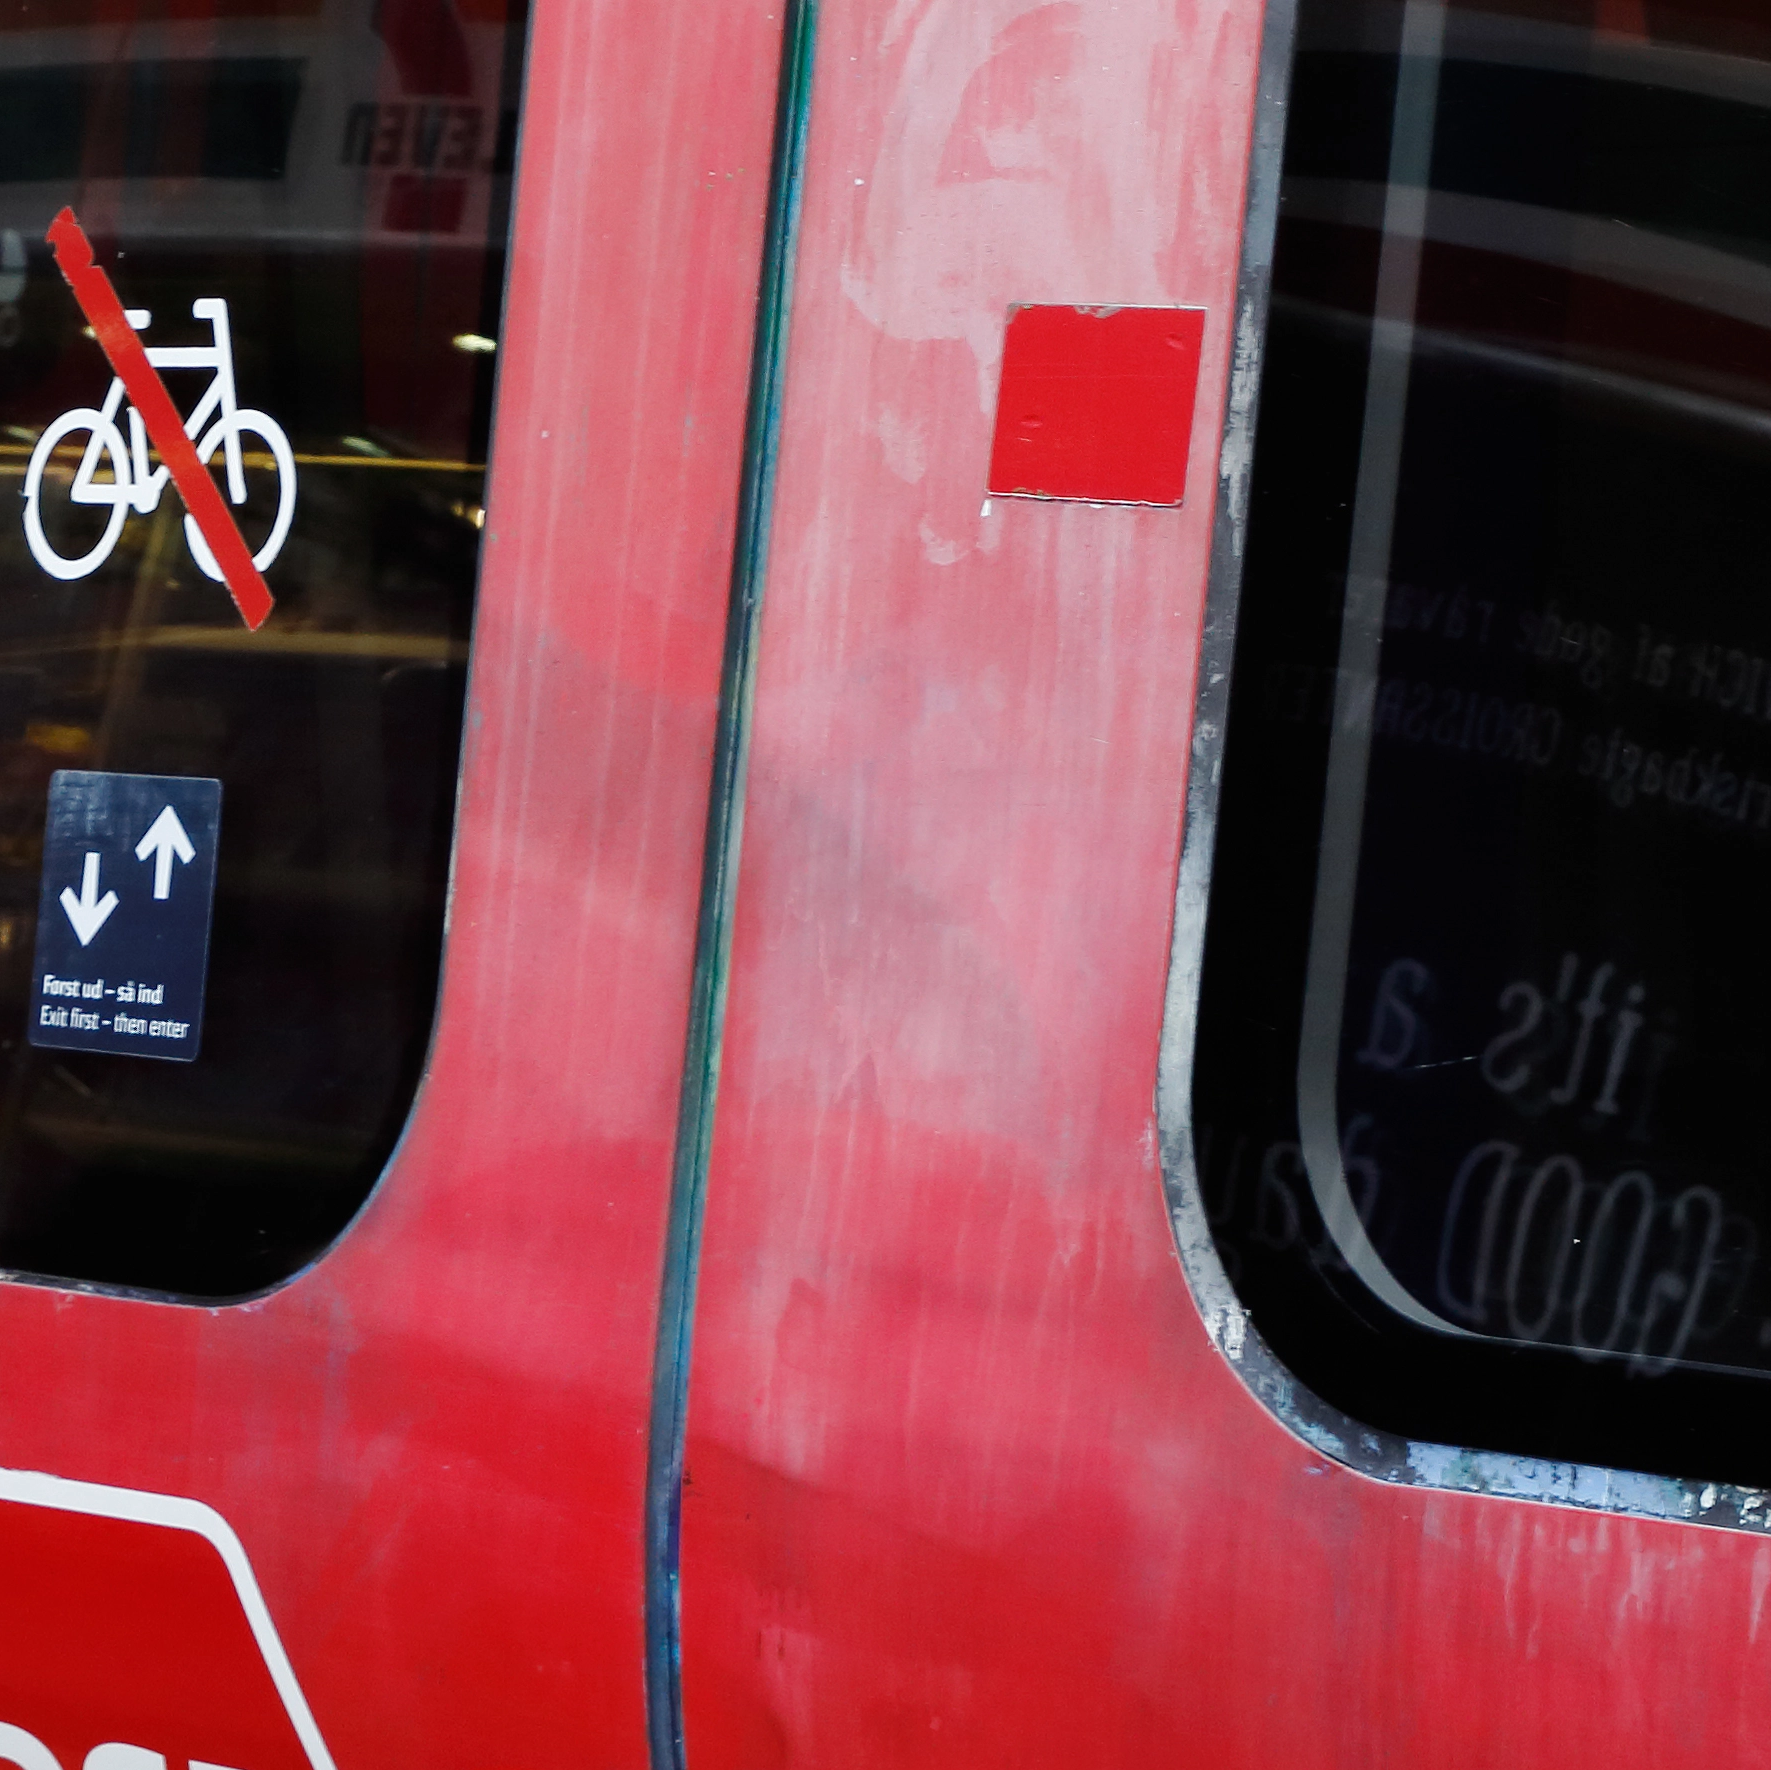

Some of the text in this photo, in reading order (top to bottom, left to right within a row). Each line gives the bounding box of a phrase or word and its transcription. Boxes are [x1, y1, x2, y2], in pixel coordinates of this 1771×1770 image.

[82, 979, 104, 1000] ud
[116, 980, 136, 1003] så
[137, 983, 164, 1006] ind
[40, 1005, 69, 1027] Exit
[69, 1006, 100, 1030] first
[113, 1012, 148, 1035] then
[148, 1019, 191, 1039] enter
